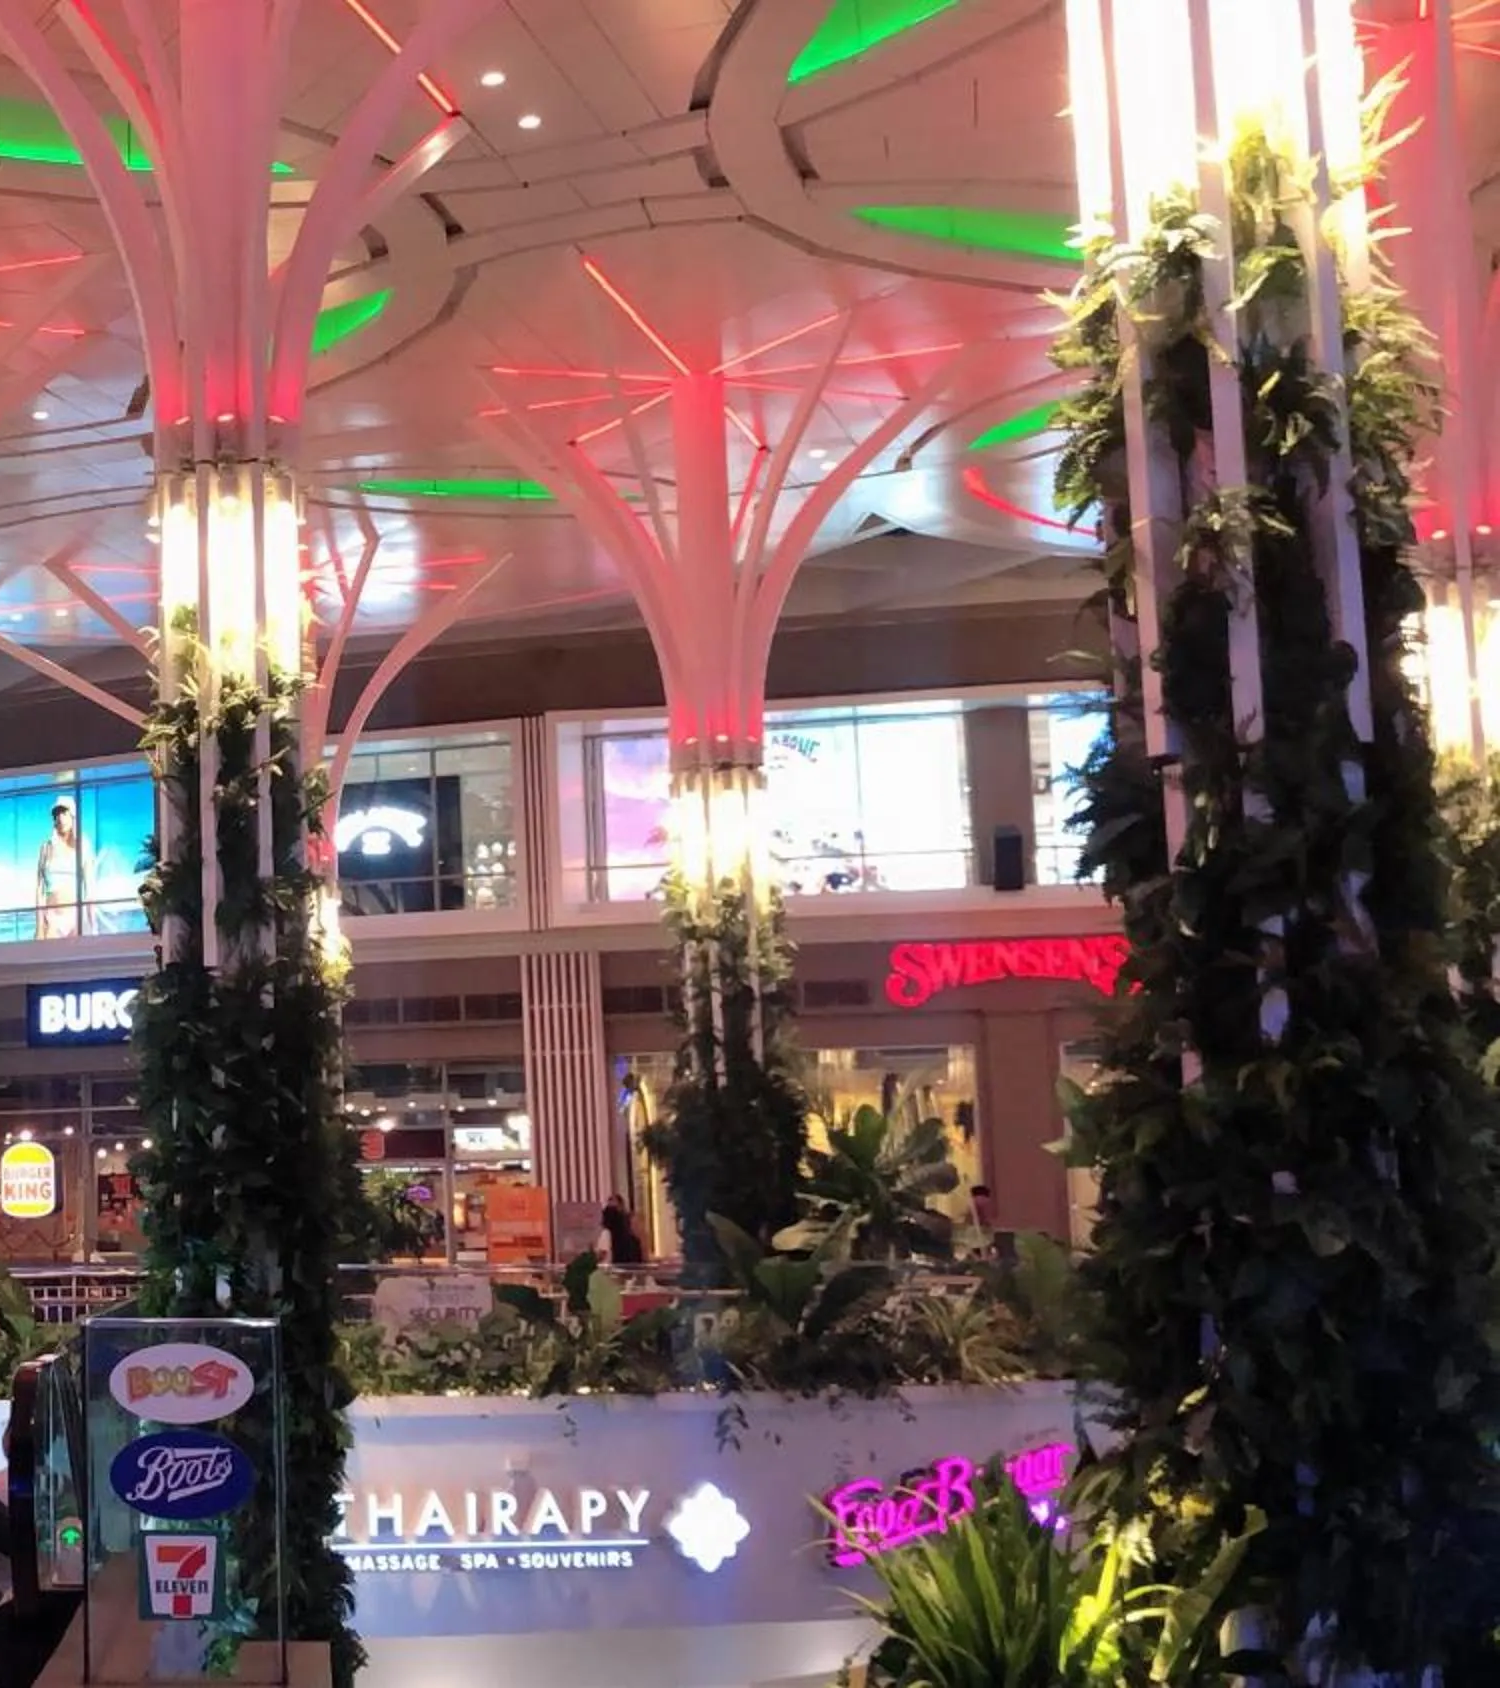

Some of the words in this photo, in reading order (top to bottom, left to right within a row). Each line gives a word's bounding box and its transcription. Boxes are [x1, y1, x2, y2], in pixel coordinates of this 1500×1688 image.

[3, 1181, 52, 1201] KING
[126, 1359, 239, 1404] BOOST
[125, 1445, 233, 1502] Boots
[332, 1489, 651, 1538] THAIRAPY
[156, 1542, 208, 1617] 7
[345, 1553, 441, 1572] MASSAGE
[459, 1552, 499, 1570] SPA
[518, 1550, 634, 1569] SOUVENIRS
